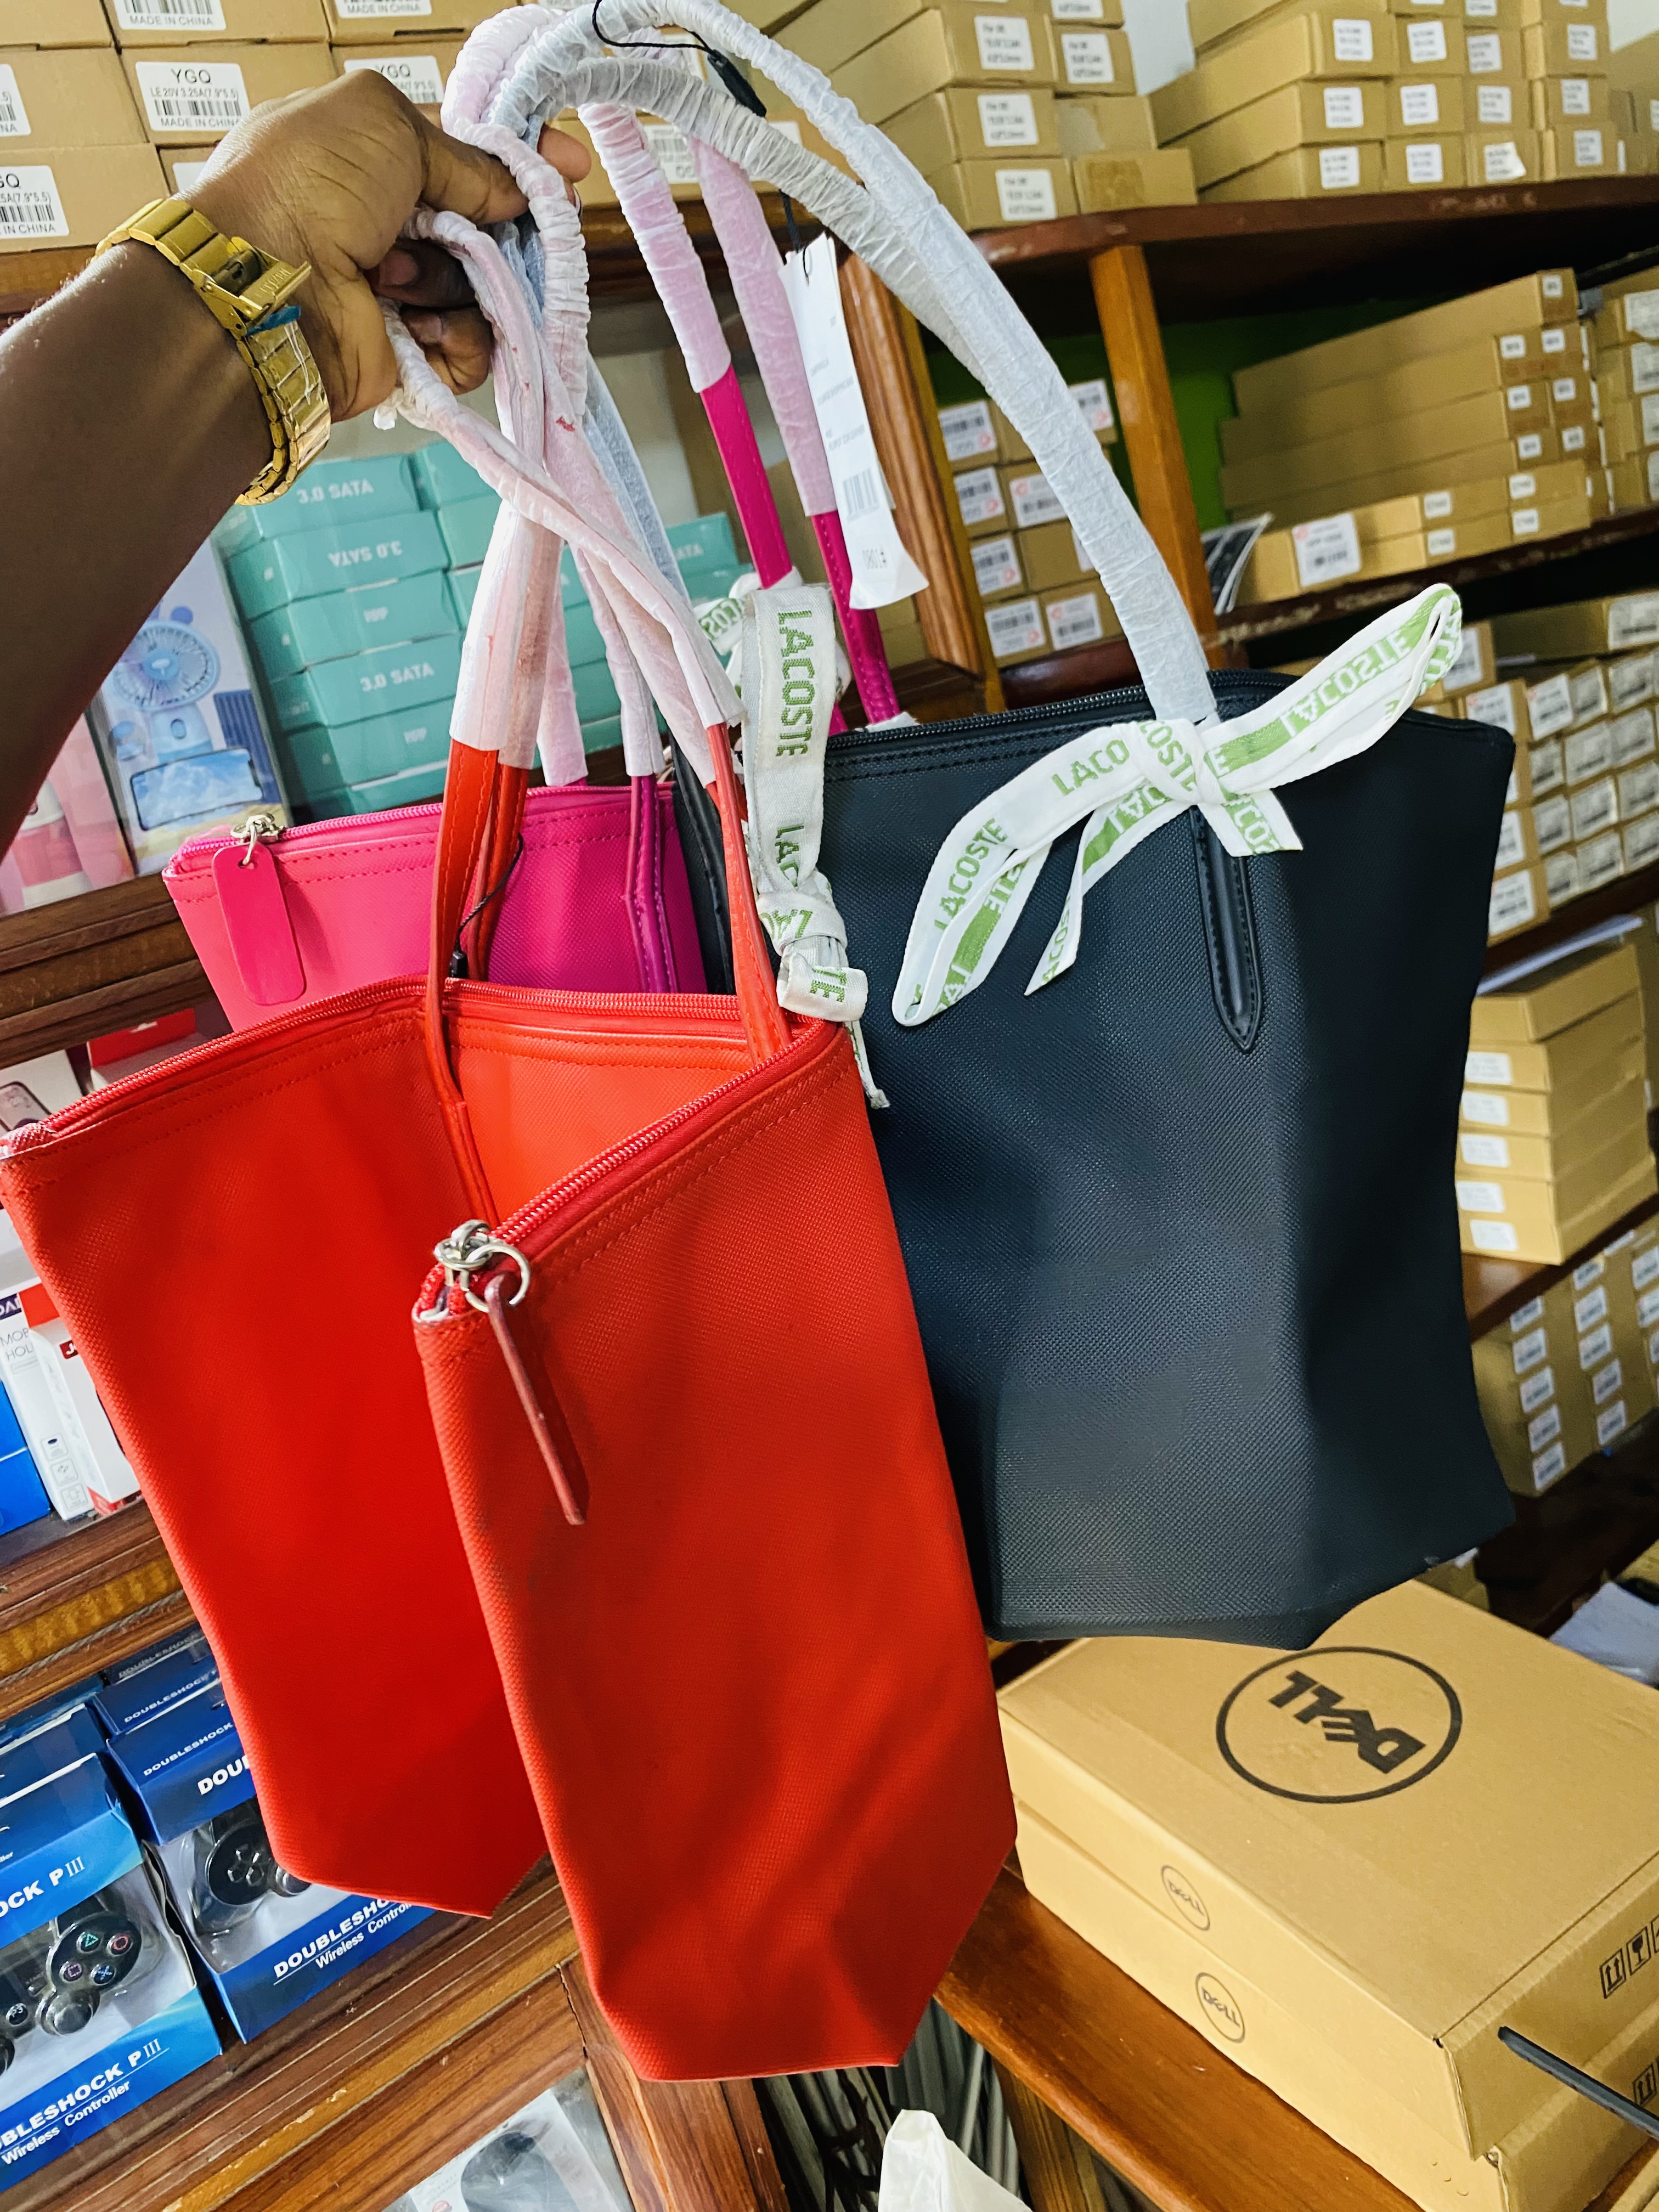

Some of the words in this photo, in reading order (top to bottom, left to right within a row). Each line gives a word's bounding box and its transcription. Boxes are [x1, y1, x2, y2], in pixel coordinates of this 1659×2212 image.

[129, 15, 161, 25] MADE
[165, 15, 176, 25] IN
[178, 15, 213, 26] CHINA
[171, 69, 212, 84] YGQ
[150, 87, 162, 97] LE
[161, 117, 192, 127] MADE
[195, 117, 206, 127] IN
[3, 224, 15, 234] IN
[18, 224, 57, 233] CHINA
[297, 485, 325, 504] 3.0
[328, 478, 374, 499] SATA
[328, 546, 373, 567] SATA
[376, 540, 403, 558] 3.0
[360, 673, 387, 692] 3.0
[390, 662, 435, 685] SATA
[776, 610, 816, 757] LACOSTE
[934, 817, 1008, 931] LACOSTE
[5, 1342, 35, 1361] HOL
[1268, 1671, 1426, 1775] DELL
[143, 1722, 234, 1776] DOUBLESHOCK
[1167, 1880, 1205, 1916] DELL
[315, 1932, 365, 1969] Wireless
[1201, 1986, 1241, 2028] DELL
[0, 2063, 124, 2151] BLESHOCK
[1, 2127, 61, 2165] Wireless
[64, 2081, 131, 2127] Controller
